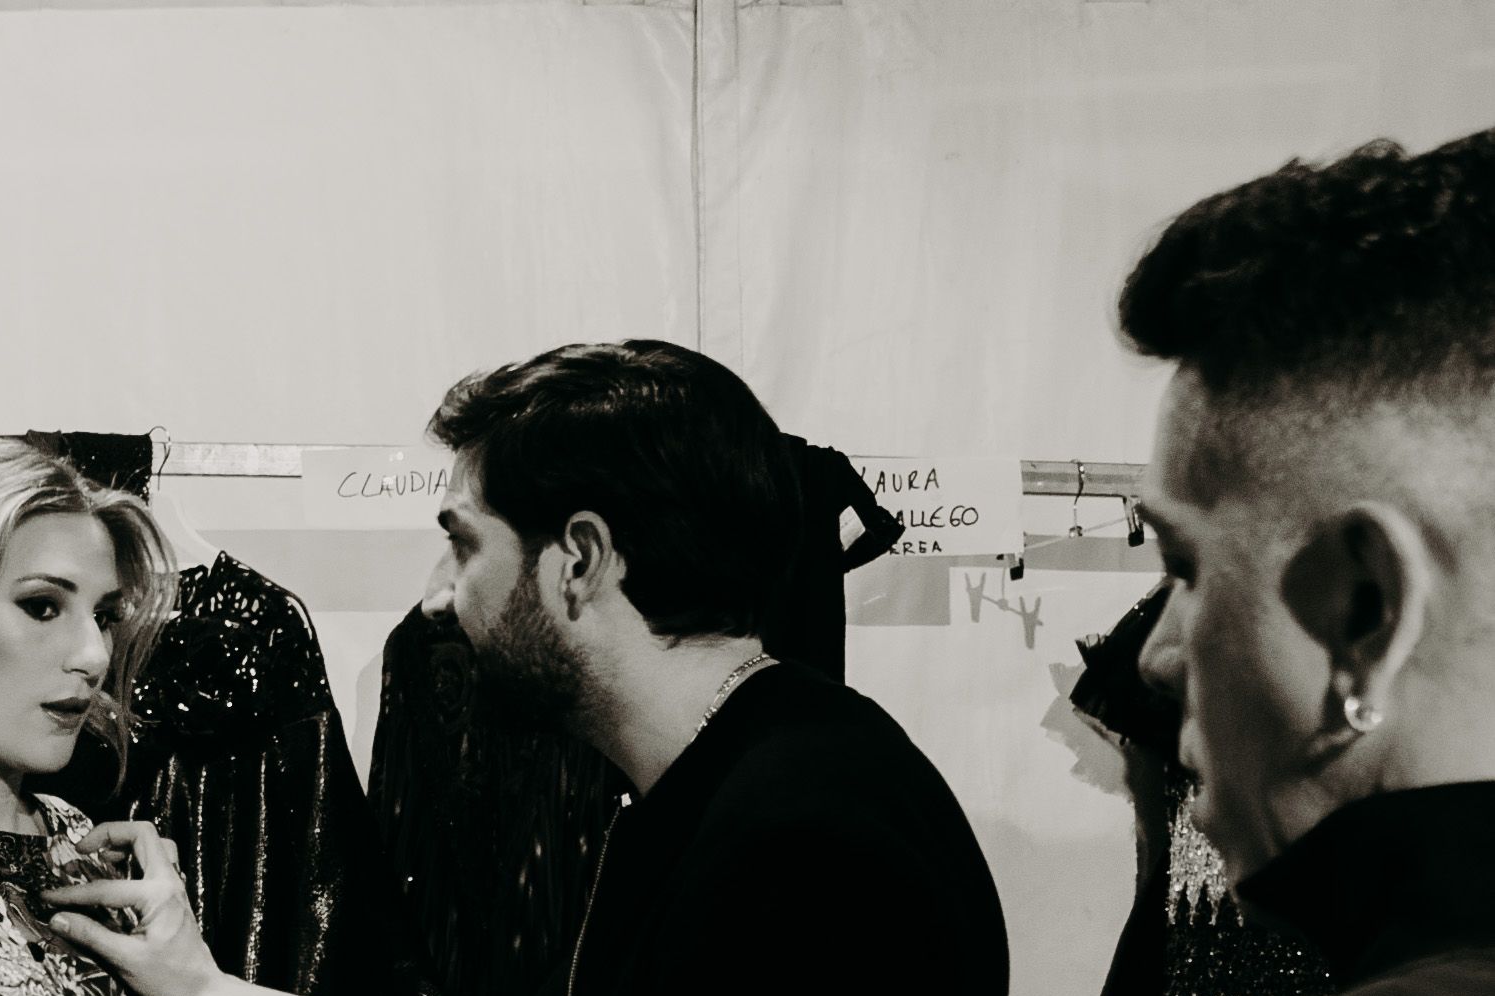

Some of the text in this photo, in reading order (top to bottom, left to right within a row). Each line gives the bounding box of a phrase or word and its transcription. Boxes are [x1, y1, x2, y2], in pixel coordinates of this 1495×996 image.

[337, 468, 448, 499] CLAUDIA
[895, 505, 979, 528] ALLEGO
[888, 540, 943, 555] EREA
